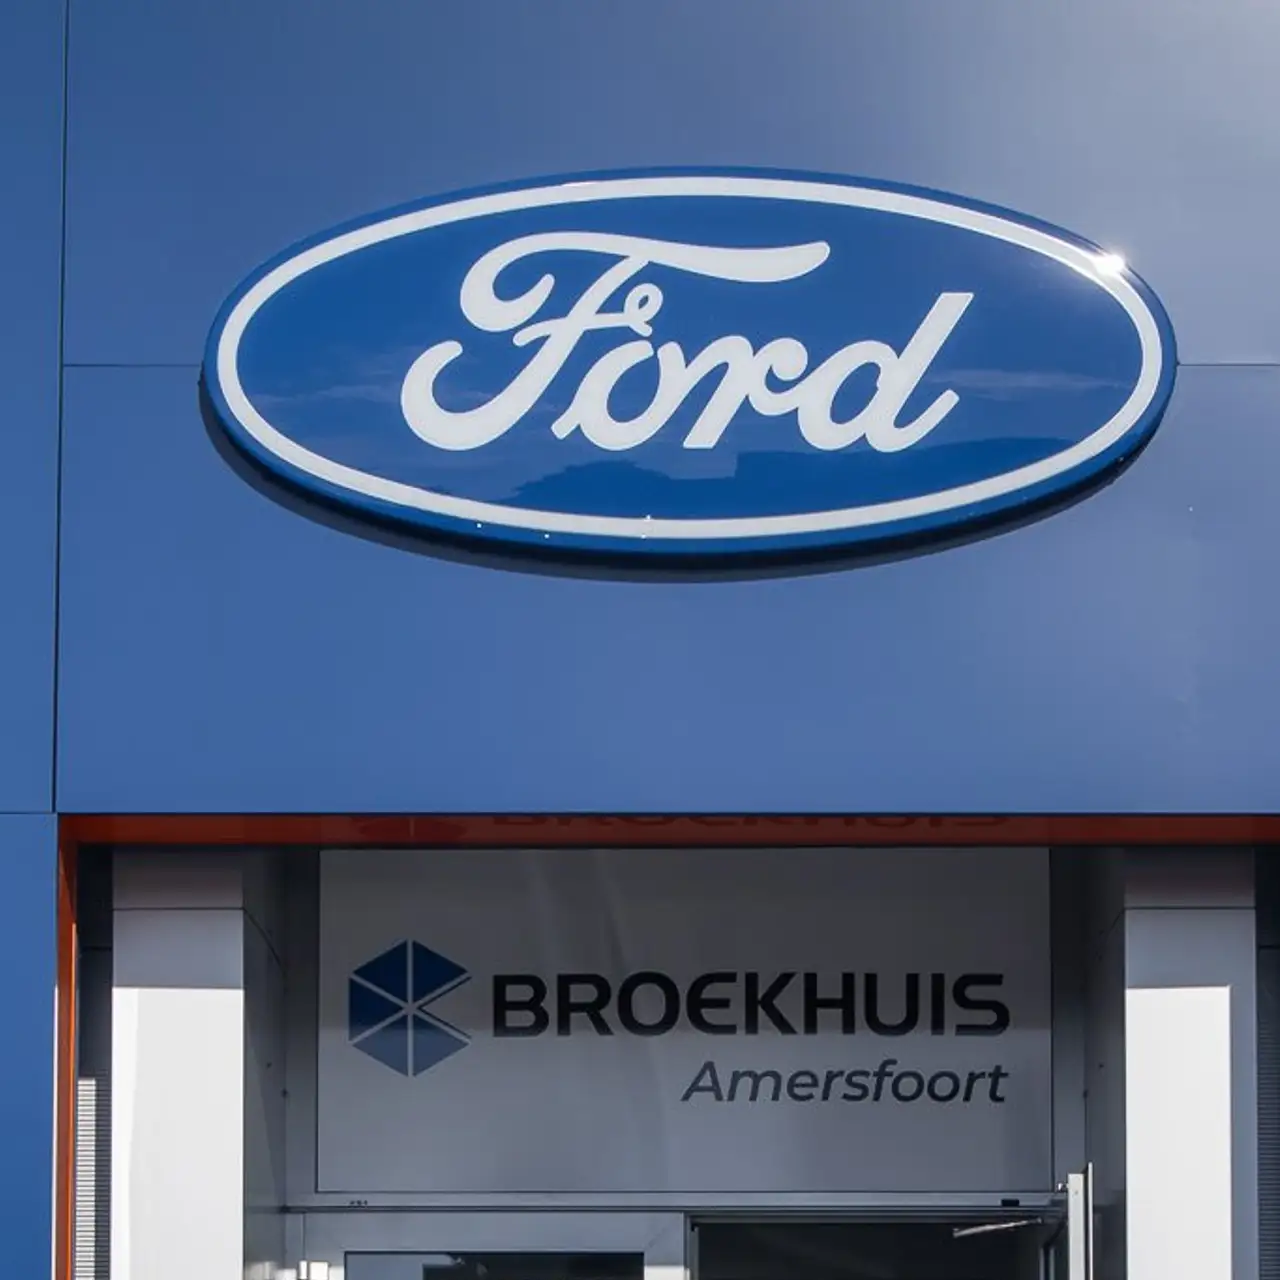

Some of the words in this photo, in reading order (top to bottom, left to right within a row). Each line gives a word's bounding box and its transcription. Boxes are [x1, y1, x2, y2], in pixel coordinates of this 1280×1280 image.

[400, 231, 974, 451] Ford
[492, 971, 1011, 1038] BROEKHUIS
[680, 1058, 1010, 1103] Amersfoort
